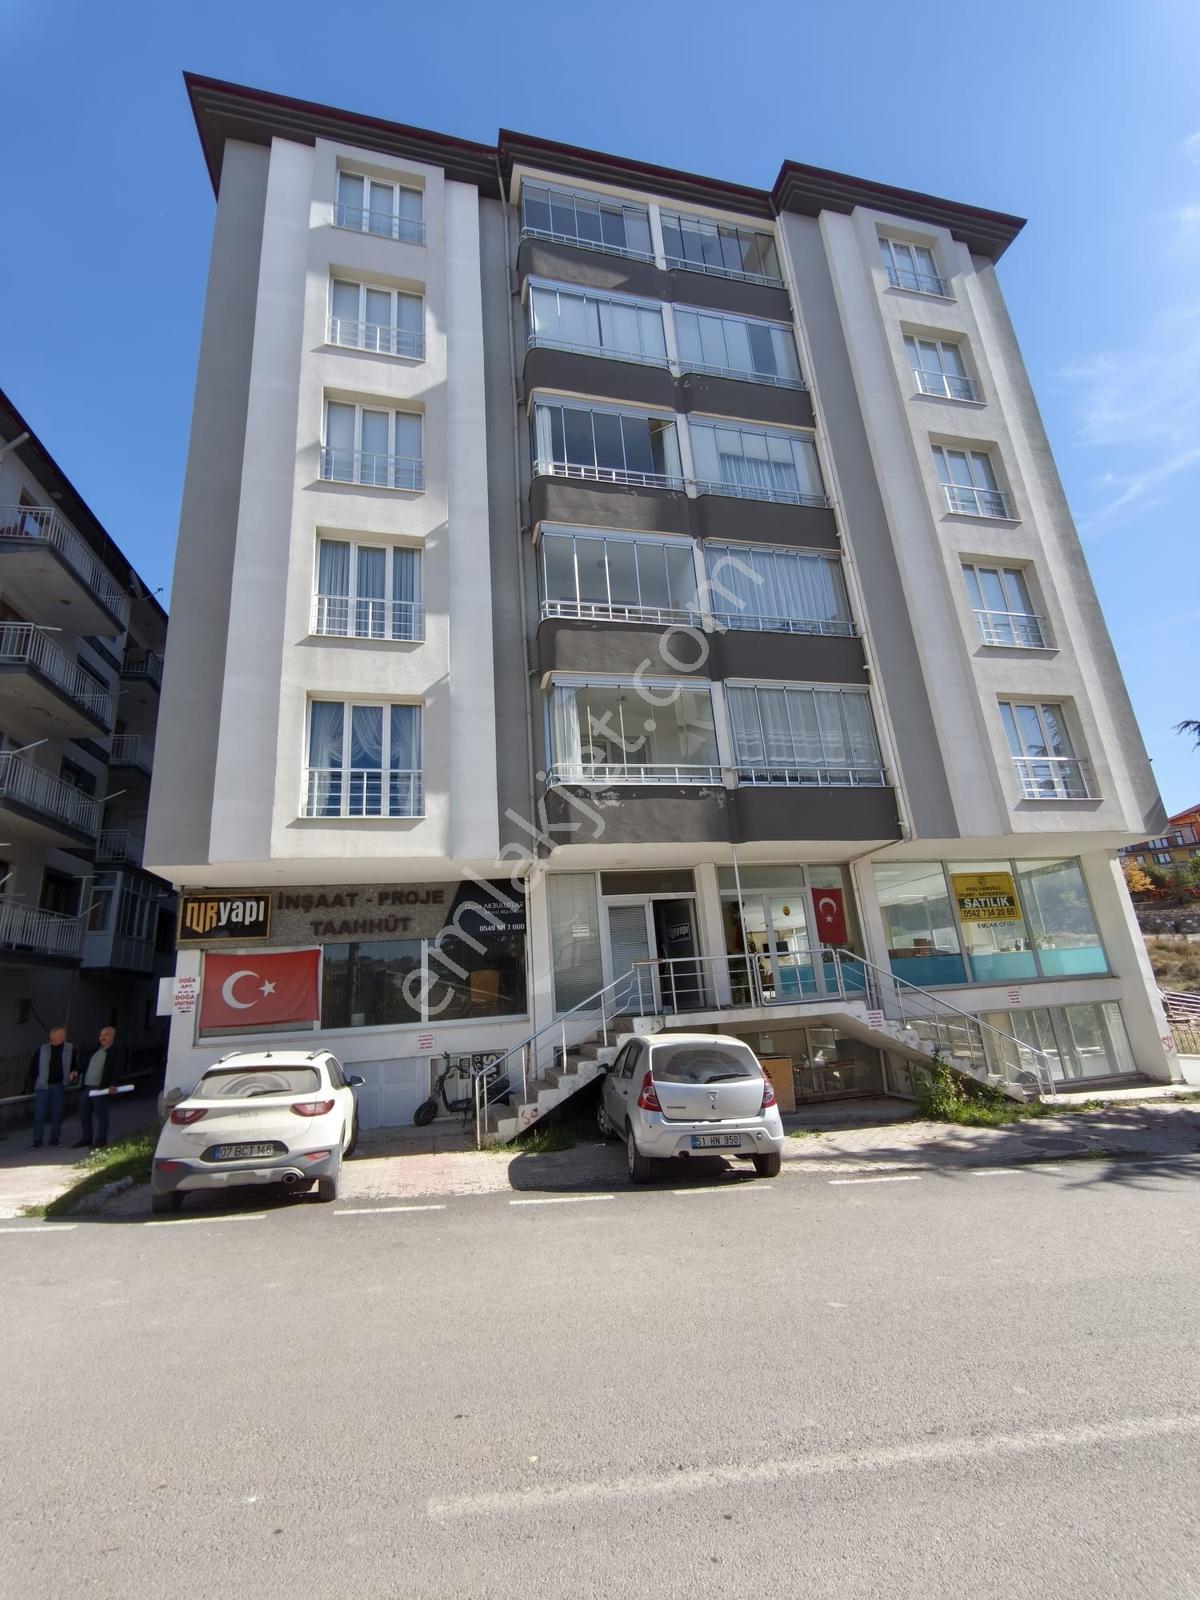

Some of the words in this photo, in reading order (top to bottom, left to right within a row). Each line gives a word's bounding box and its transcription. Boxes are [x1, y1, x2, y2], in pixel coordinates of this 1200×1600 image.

[277, 890, 359, 914] İNŞAAT
[378, 888, 446, 907] PROJE
[964, 898, 1010, 909] SATILIK
[963, 909, 981, 917] 0542
[981, 908, 995, 917] 734
[996, 908, 1005, 917] 20
[310, 914, 412, 936] TAAHHÜT
[175, 993, 195, 1001] DOĞA
[696, 1136, 705, 1146] 51
[710, 1136, 721, 1146] HN
[724, 1135, 739, 1145] 950
[220, 1147, 231, 1157] 07
[234, 1146, 254, 1157] BCT
[256, 1144, 273, 1156] 146
